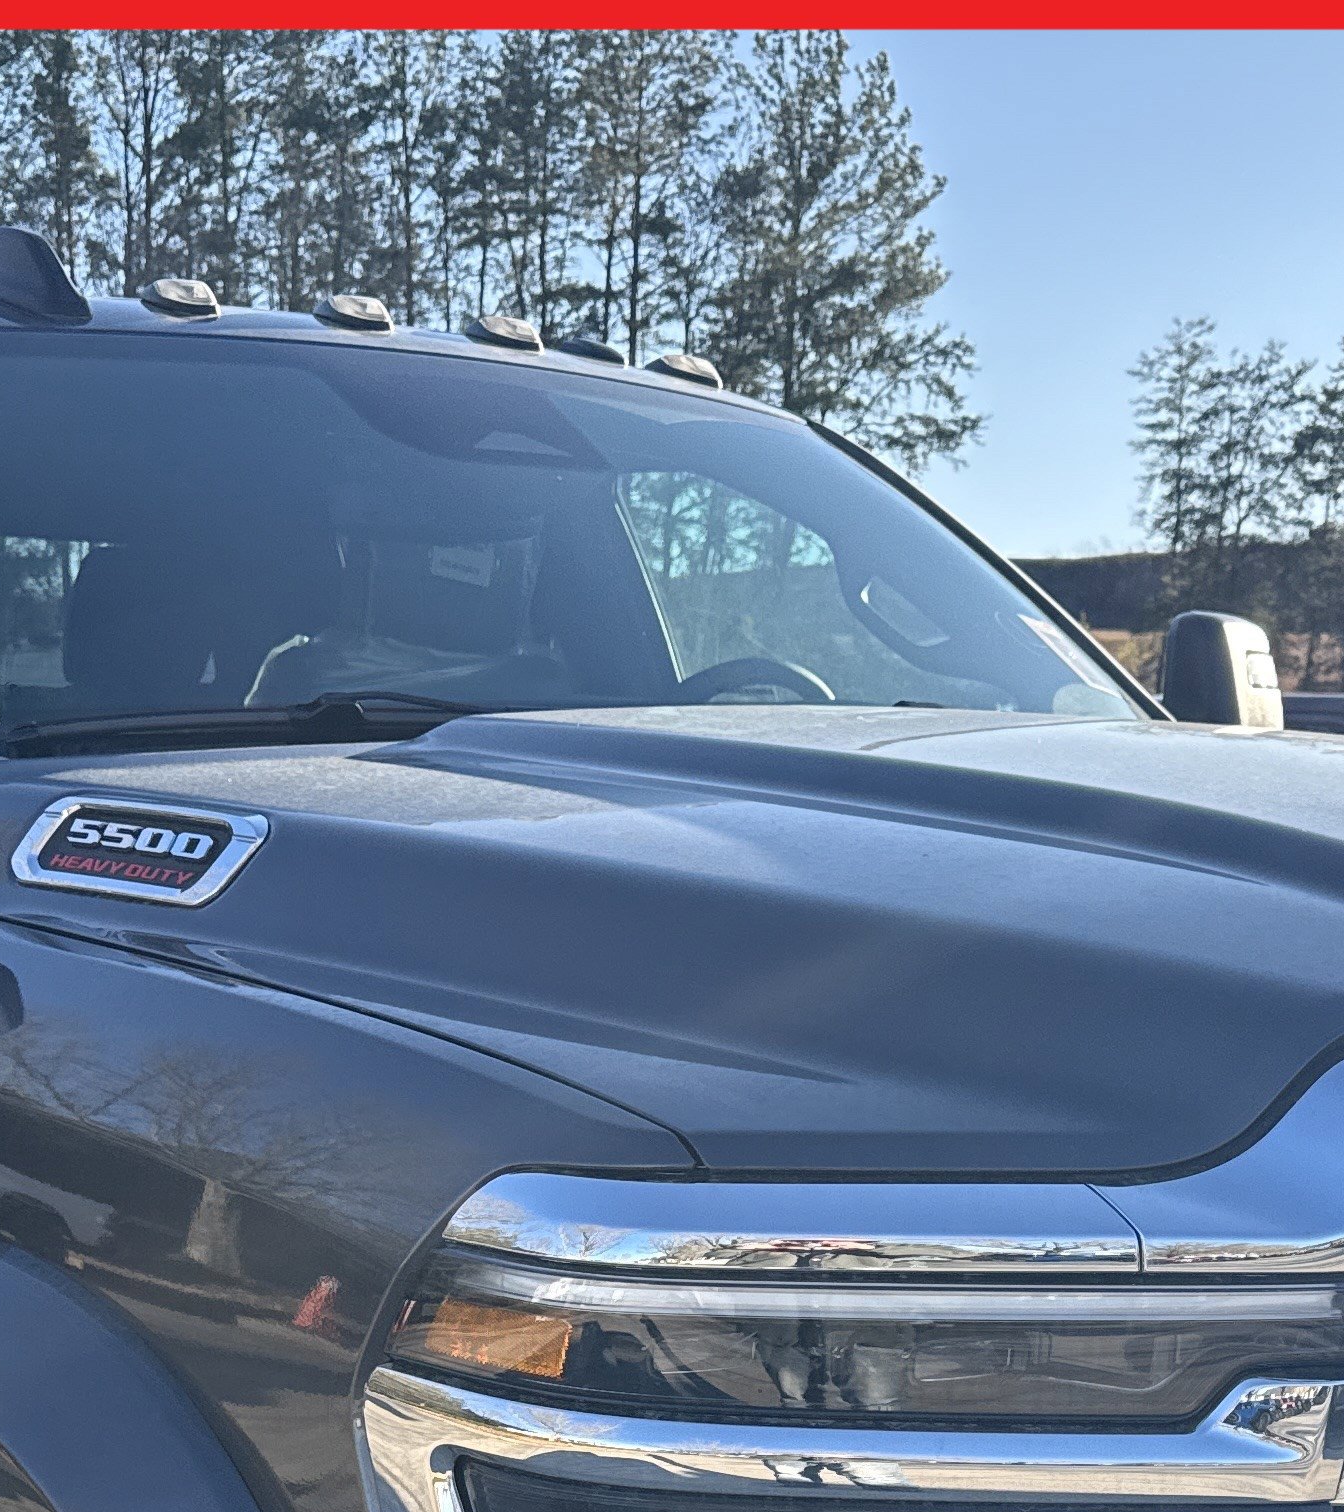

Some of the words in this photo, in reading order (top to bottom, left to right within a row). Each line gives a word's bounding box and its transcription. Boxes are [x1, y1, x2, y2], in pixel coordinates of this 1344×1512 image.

[66, 818, 213, 859] 5500
[50, 854, 126, 876] HEAVY
[122, 863, 194, 885] DUTY
